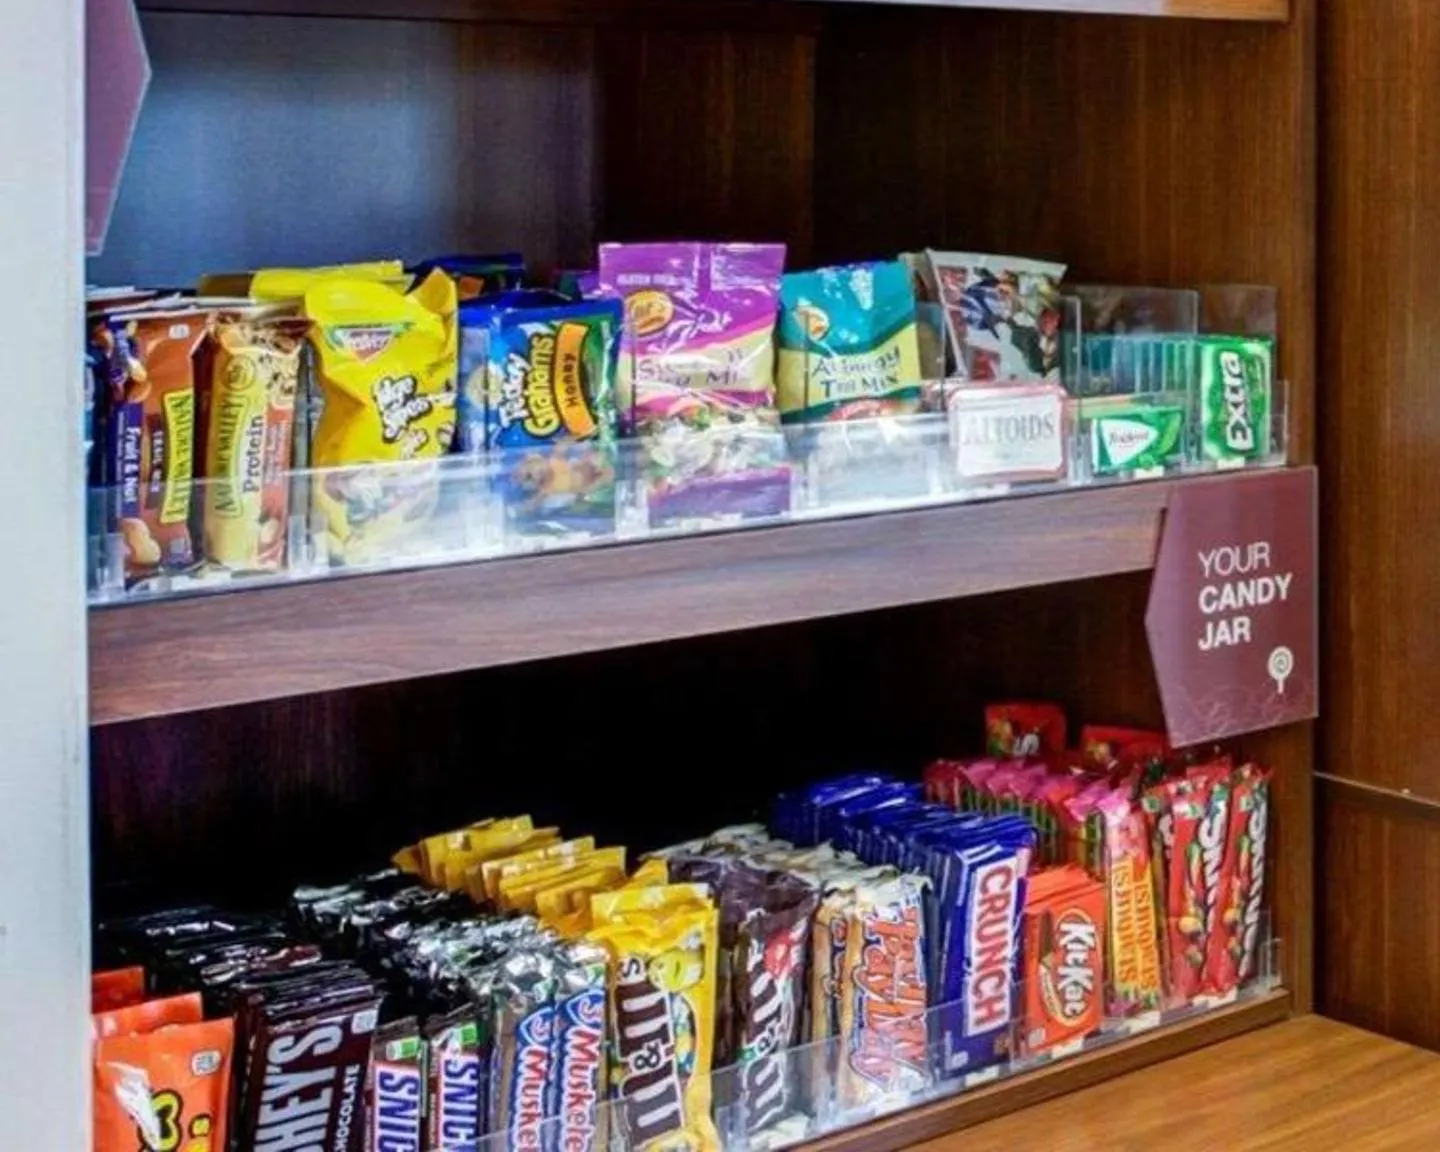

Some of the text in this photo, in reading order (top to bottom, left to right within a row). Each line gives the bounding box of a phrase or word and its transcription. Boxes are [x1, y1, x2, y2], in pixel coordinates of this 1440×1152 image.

[500, 353, 531, 428] Teddy
[522, 334, 562, 437] Grahams
[563, 352, 578, 409] Honey
[124, 426, 141, 461] Fruit
[242, 415, 264, 493] Protein
[123, 476, 138, 504] Nut
[1198, 542, 1271, 578] YOUR
[1198, 573, 1293, 615] CANDY
[1198, 616, 1252, 650] JAR
[971, 864, 1013, 1028] CRUNCH
